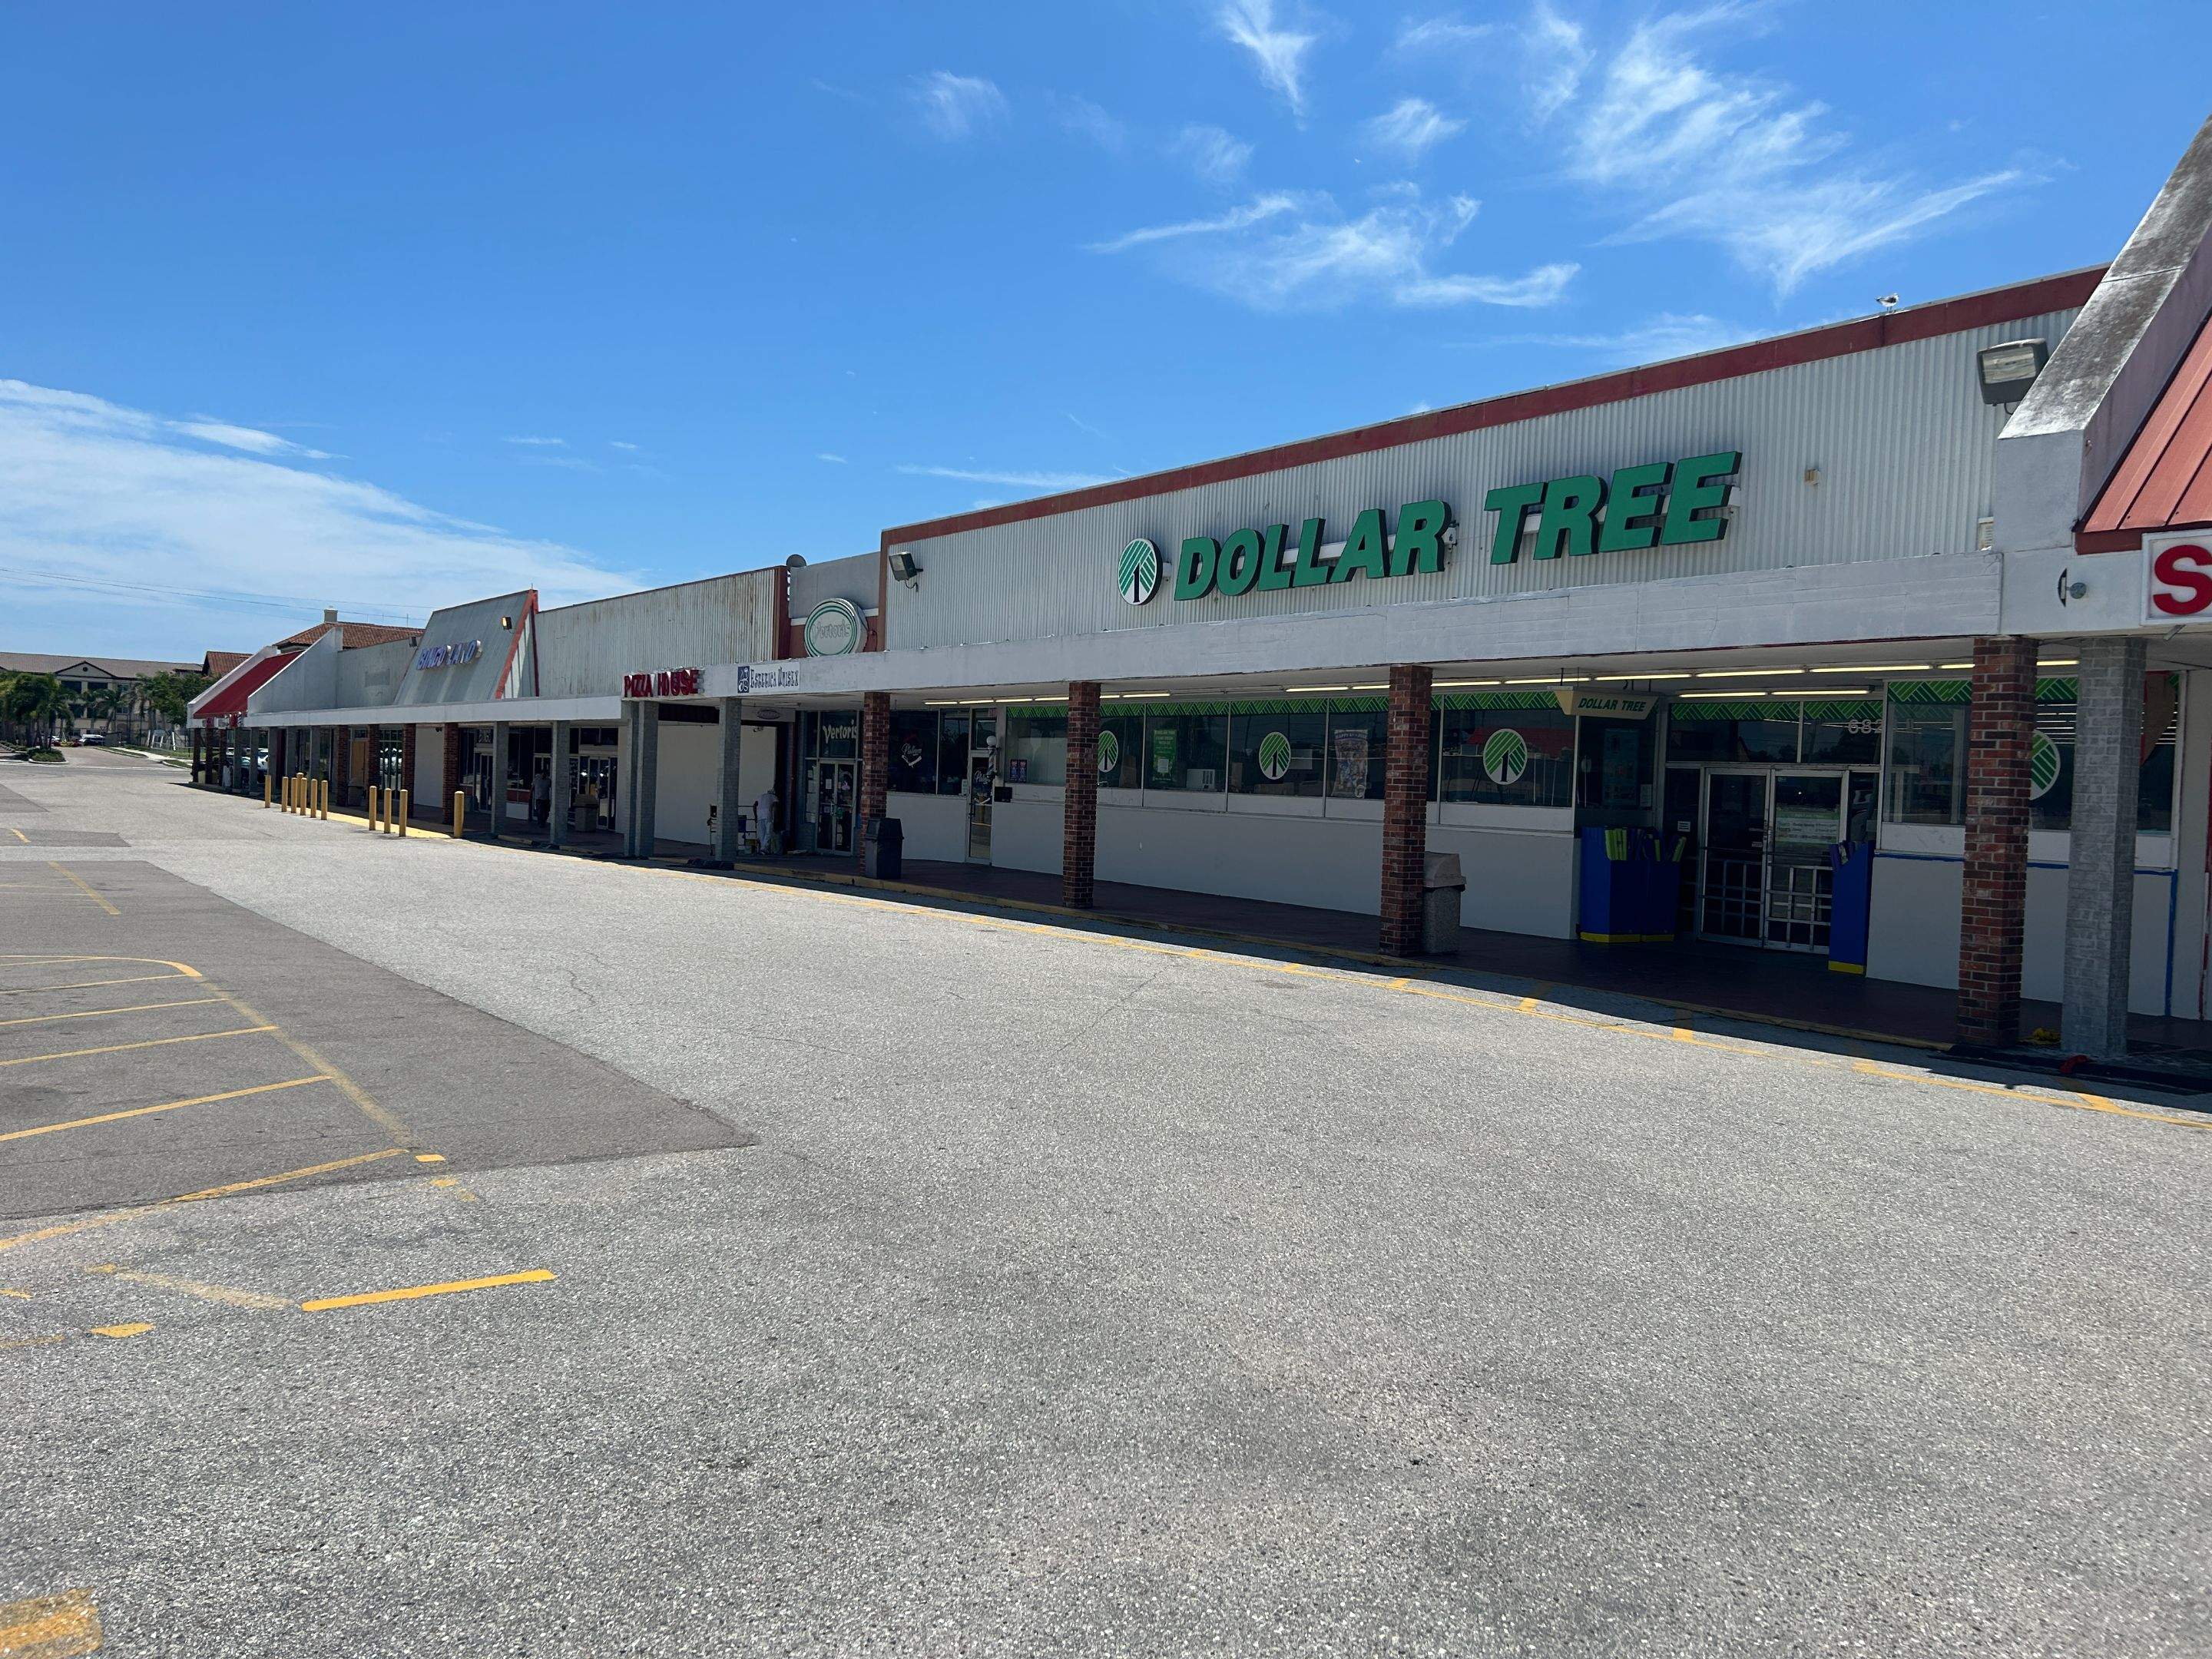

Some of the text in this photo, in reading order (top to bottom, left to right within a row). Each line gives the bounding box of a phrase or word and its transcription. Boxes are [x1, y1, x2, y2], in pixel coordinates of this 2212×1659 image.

[1174, 450, 1743, 601] DOLLAR TREE
[2153, 544, 2212, 615] S
[624, 669, 699, 698] PIZZA HOUSE
[1578, 697, 1647, 712] DOLLAR TREE
[822, 719, 858, 744] Vertoris
